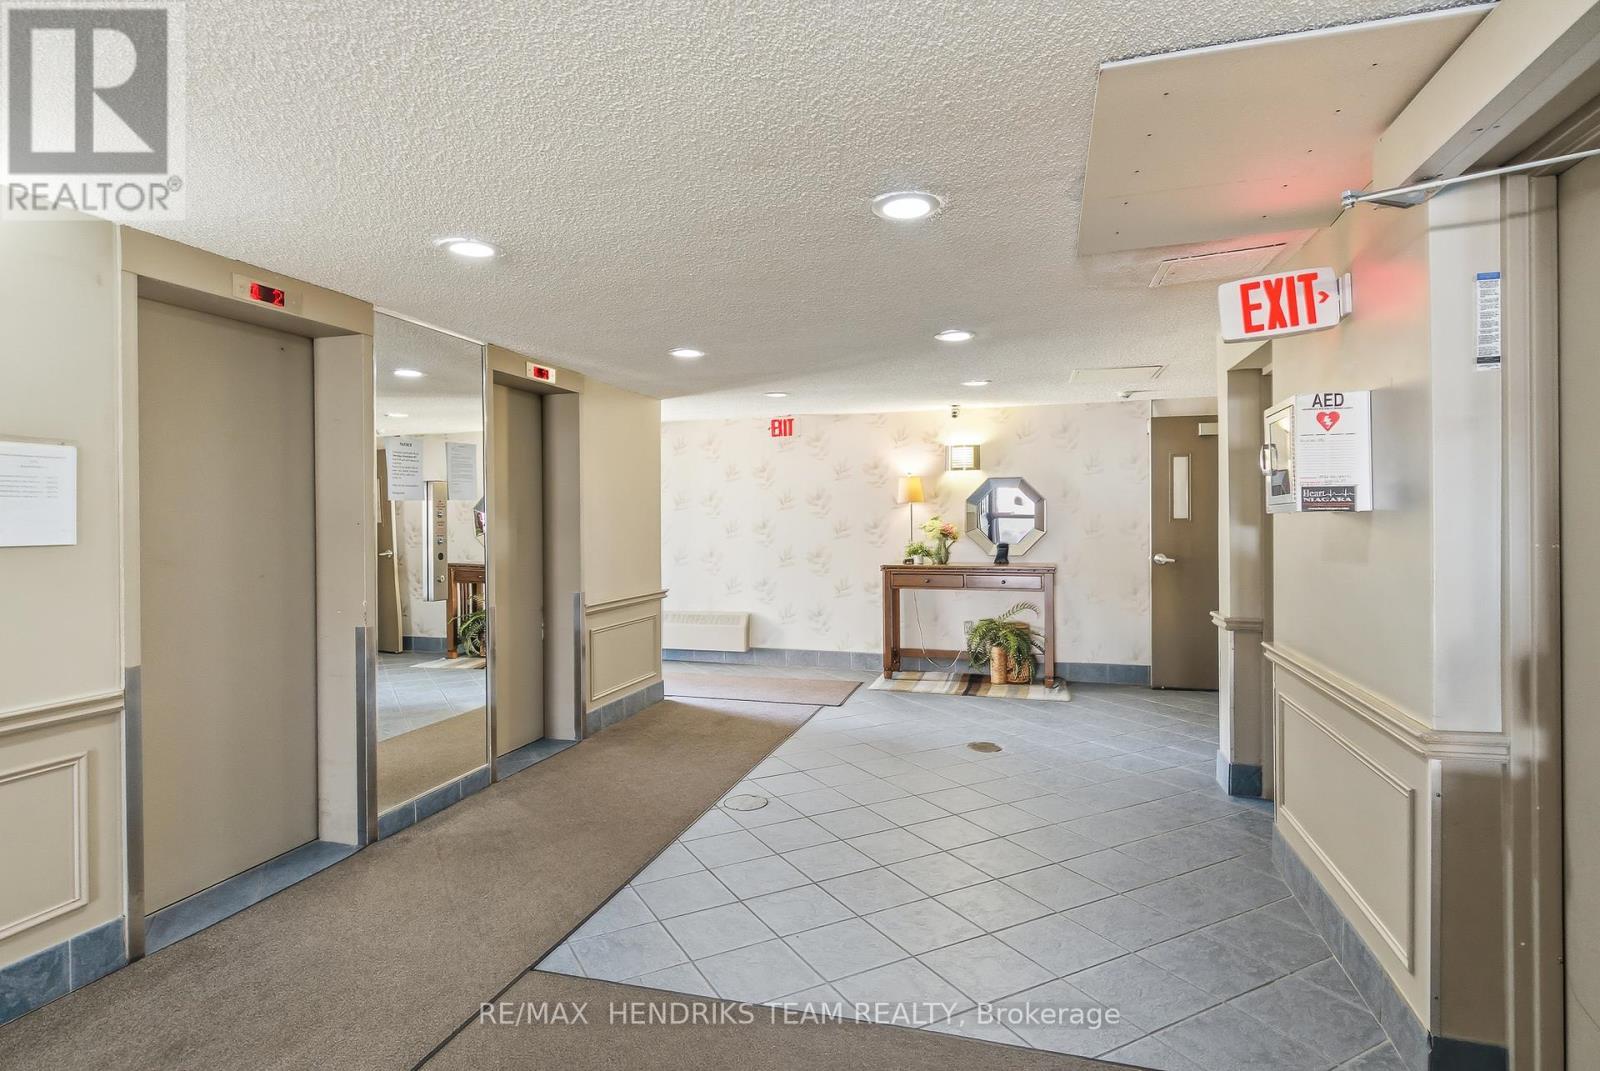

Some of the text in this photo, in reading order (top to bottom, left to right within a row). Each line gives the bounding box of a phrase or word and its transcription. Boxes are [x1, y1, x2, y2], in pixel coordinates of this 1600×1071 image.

[1239, 272, 1319, 335] EXIT
[1312, 393, 1344, 408] AED
[771, 418, 794, 437] EXIT
